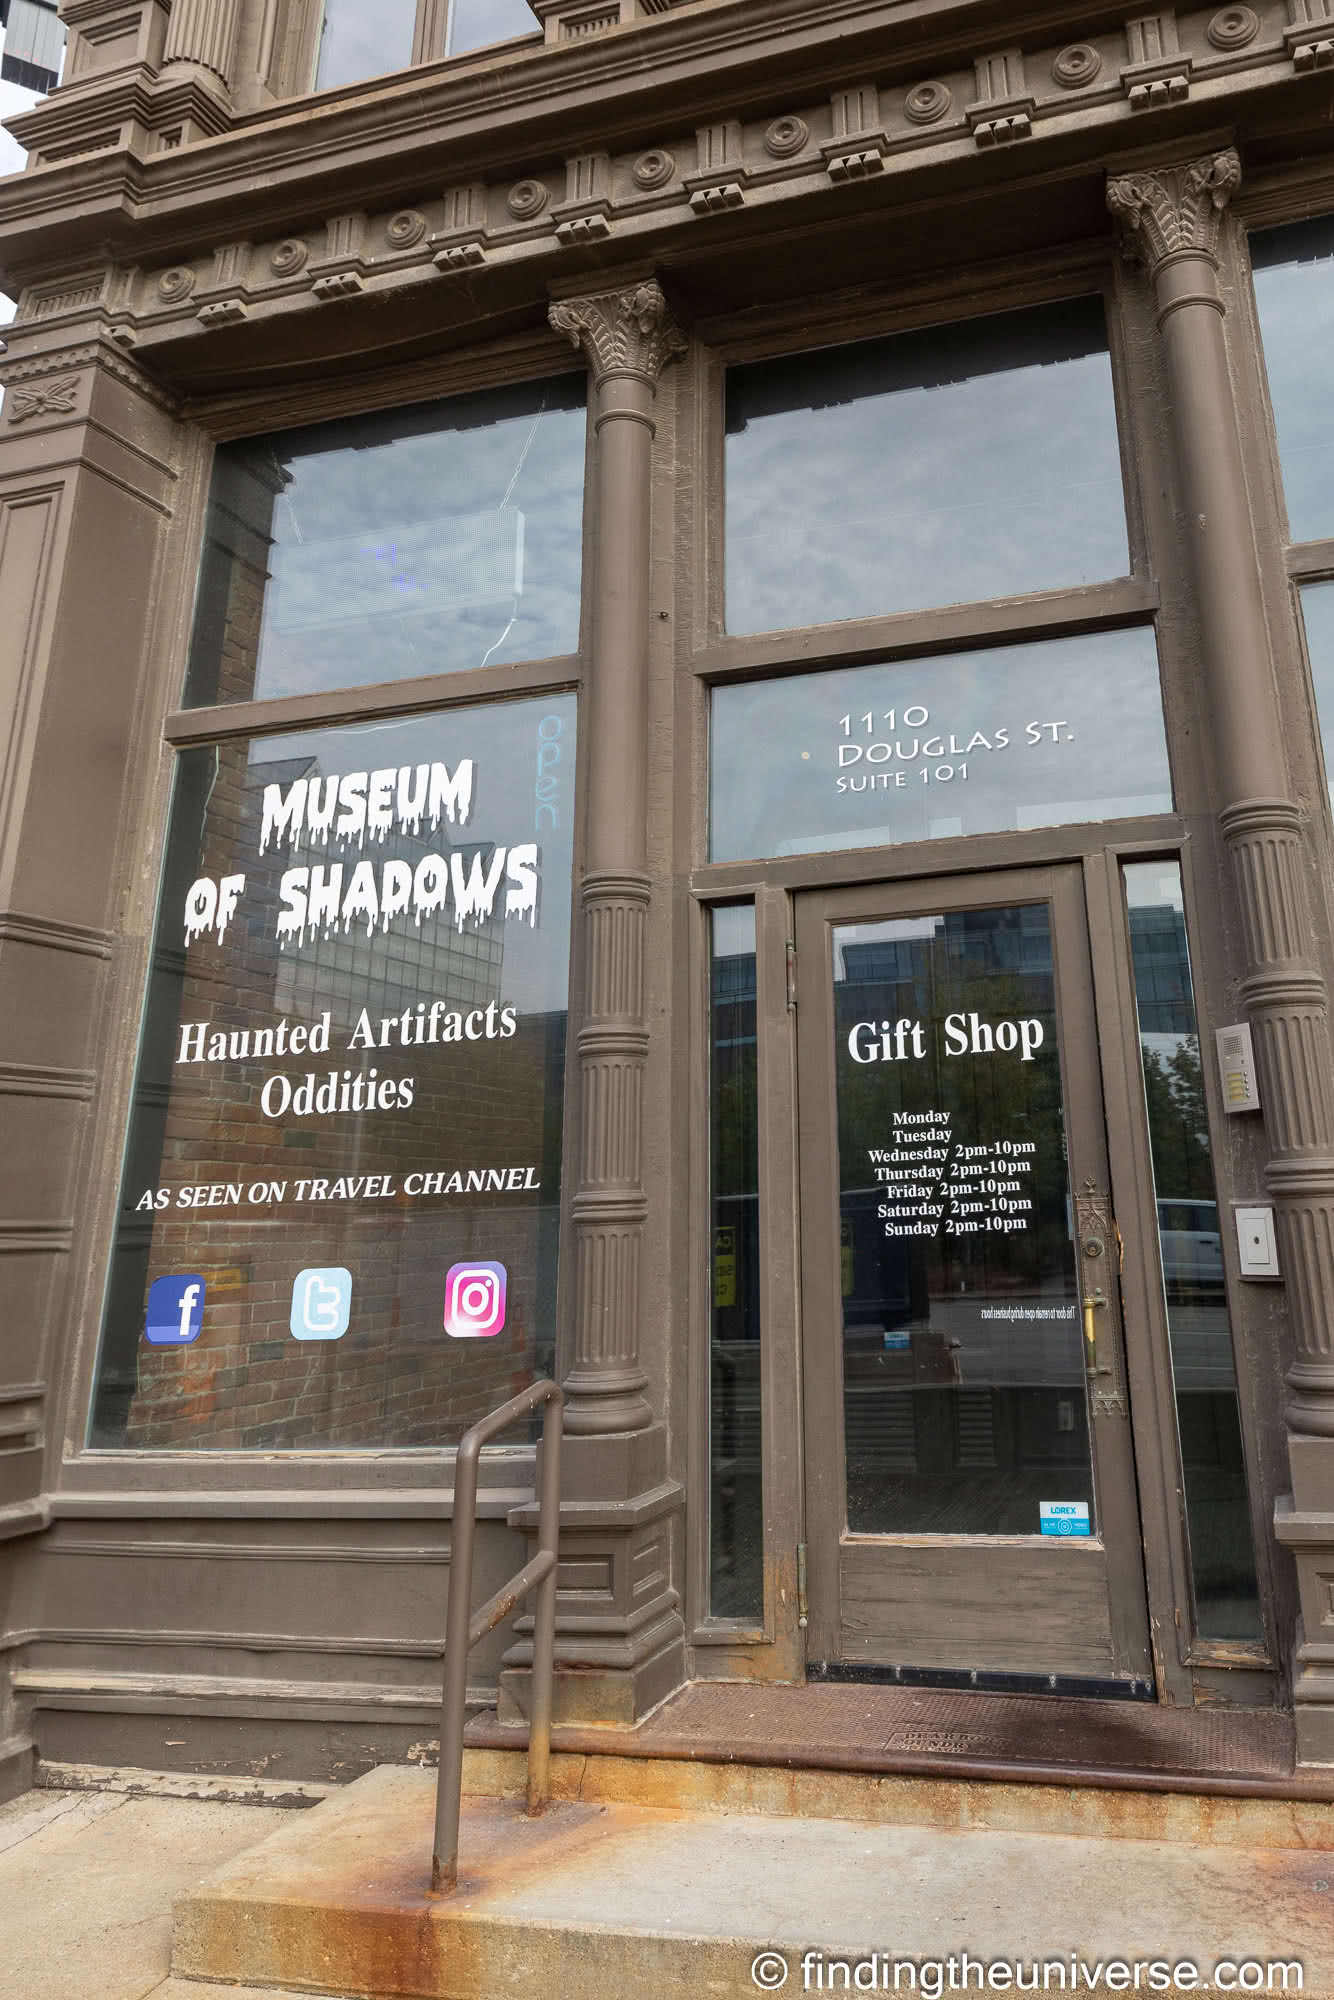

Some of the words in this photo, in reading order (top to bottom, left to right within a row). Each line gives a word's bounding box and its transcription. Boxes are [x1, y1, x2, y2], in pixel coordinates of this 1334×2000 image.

[839, 705, 929, 736] 1110
[838, 728, 1009, 767] DOUGLAS
[1025, 720, 1074, 745] ST.
[836, 771, 906, 793] SUITE
[919, 762, 967, 784] 101
[259, 758, 474, 857] MUSEUM
[183, 872, 246, 948] OF
[275, 843, 538, 950] SHADOWS
[175, 1011, 331, 1064] Haunted
[346, 999, 518, 1050] Artifacts
[848, 1018, 927, 1064] Gift
[944, 1012, 1044, 1061] Shop
[260, 1068, 414, 1118] Oddities
[892, 1109, 951, 1126] Monday
[892, 1127, 952, 1144] Tuesday
[868, 1146, 949, 1163] Wednesday
[955, 1140, 1036, 1159] 2pm-10pm
[874, 1164, 944, 1181] Thursday
[950, 1159, 1031, 1178] 2pm-10pm
[135, 1188, 171, 1211] AS
[175, 1183, 244, 1208] SEEN
[247, 1180, 288, 1204] ON
[293, 1175, 397, 1201] TRAVEL
[403, 1167, 541, 1196] CHANNEL
[886, 1184, 934, 1200] Friday
[939, 1178, 1021, 1197] 2pm-10pm
[877, 1201, 945, 1218] Saturday
[951, 1197, 1032, 1216] 2pm-10pm
[885, 1220, 939, 1237] Sunday
[945, 1216, 1027, 1236] 2pm-10pm
[1050, 1506, 1077, 1515] LOREX
